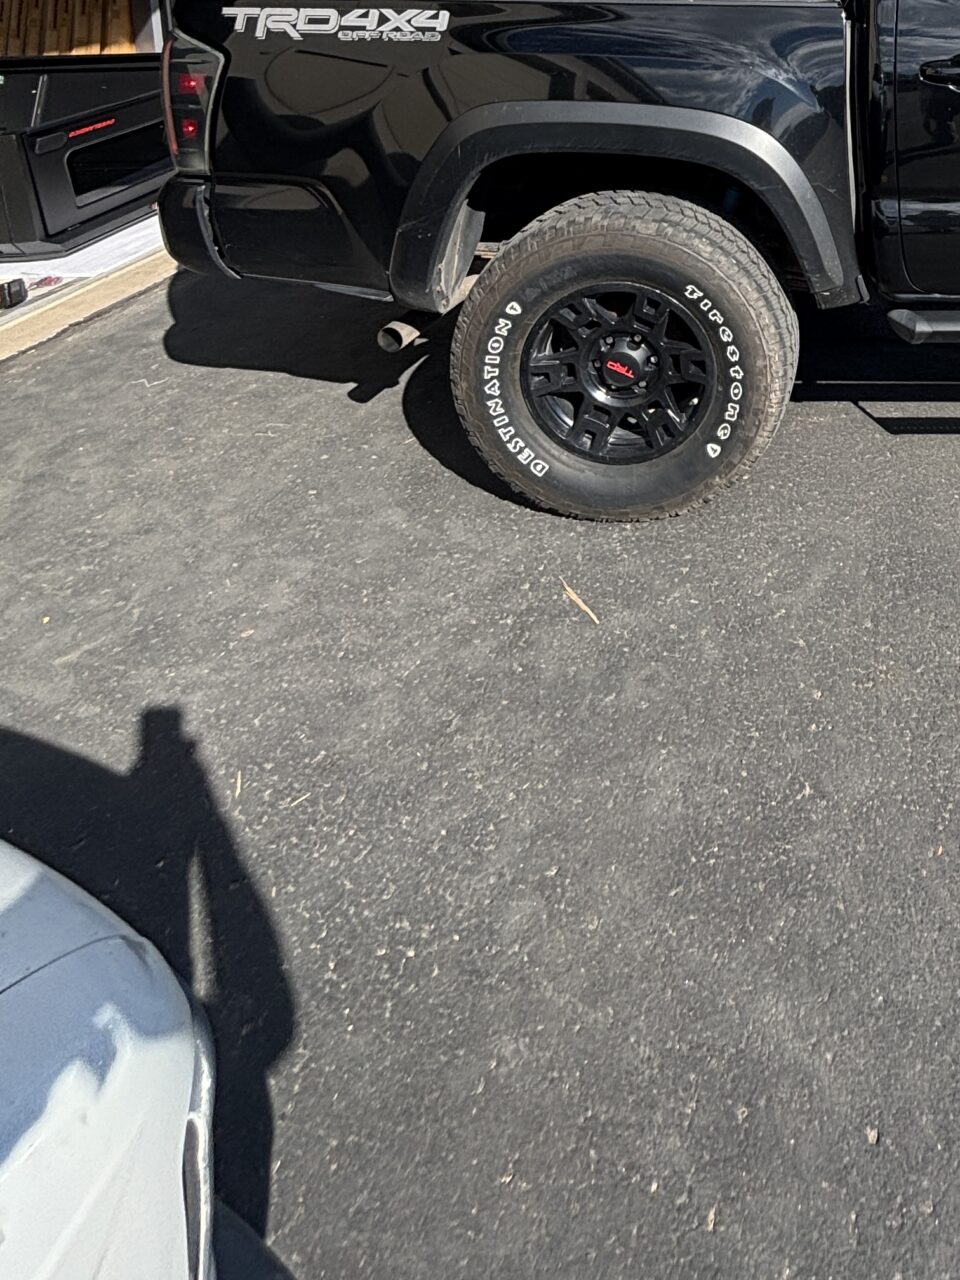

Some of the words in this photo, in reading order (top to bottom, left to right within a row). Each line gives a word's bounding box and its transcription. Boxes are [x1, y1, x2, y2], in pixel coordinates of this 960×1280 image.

[338, 30, 381, 41] OFF
[381, 31, 442, 41] ROAD
[484, 318, 549, 477] DESTINATION
[684, 284, 744, 440] Firestone
